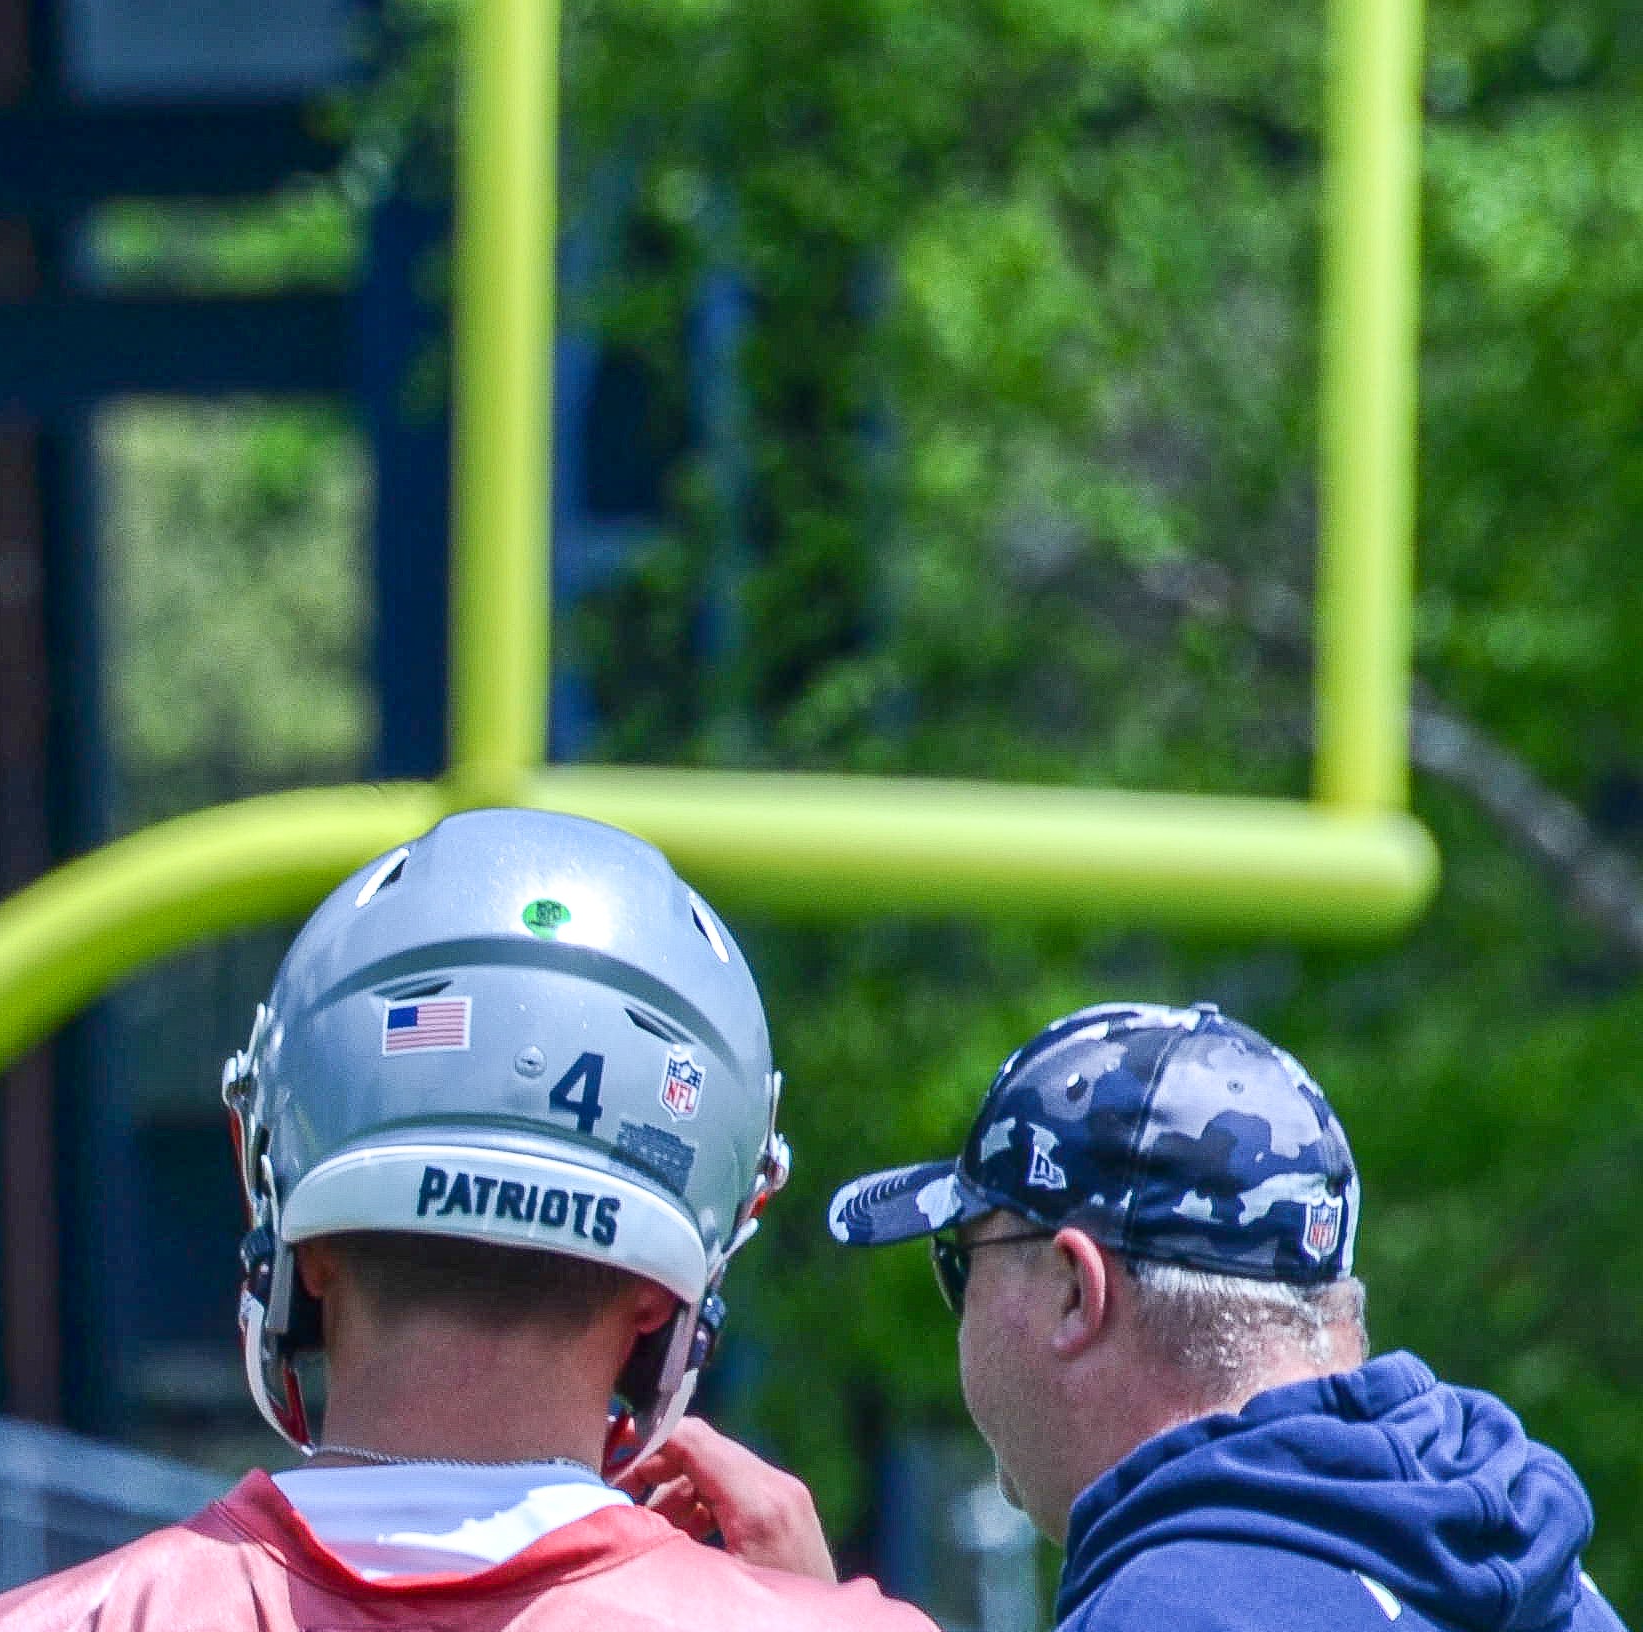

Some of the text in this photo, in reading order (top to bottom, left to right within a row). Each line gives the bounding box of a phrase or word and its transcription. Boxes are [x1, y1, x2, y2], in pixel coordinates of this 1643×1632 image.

[549, 1052, 605, 1136] 4
[666, 1078, 693, 1114] NFL
[417, 1165, 621, 1246] PATRIOTS
